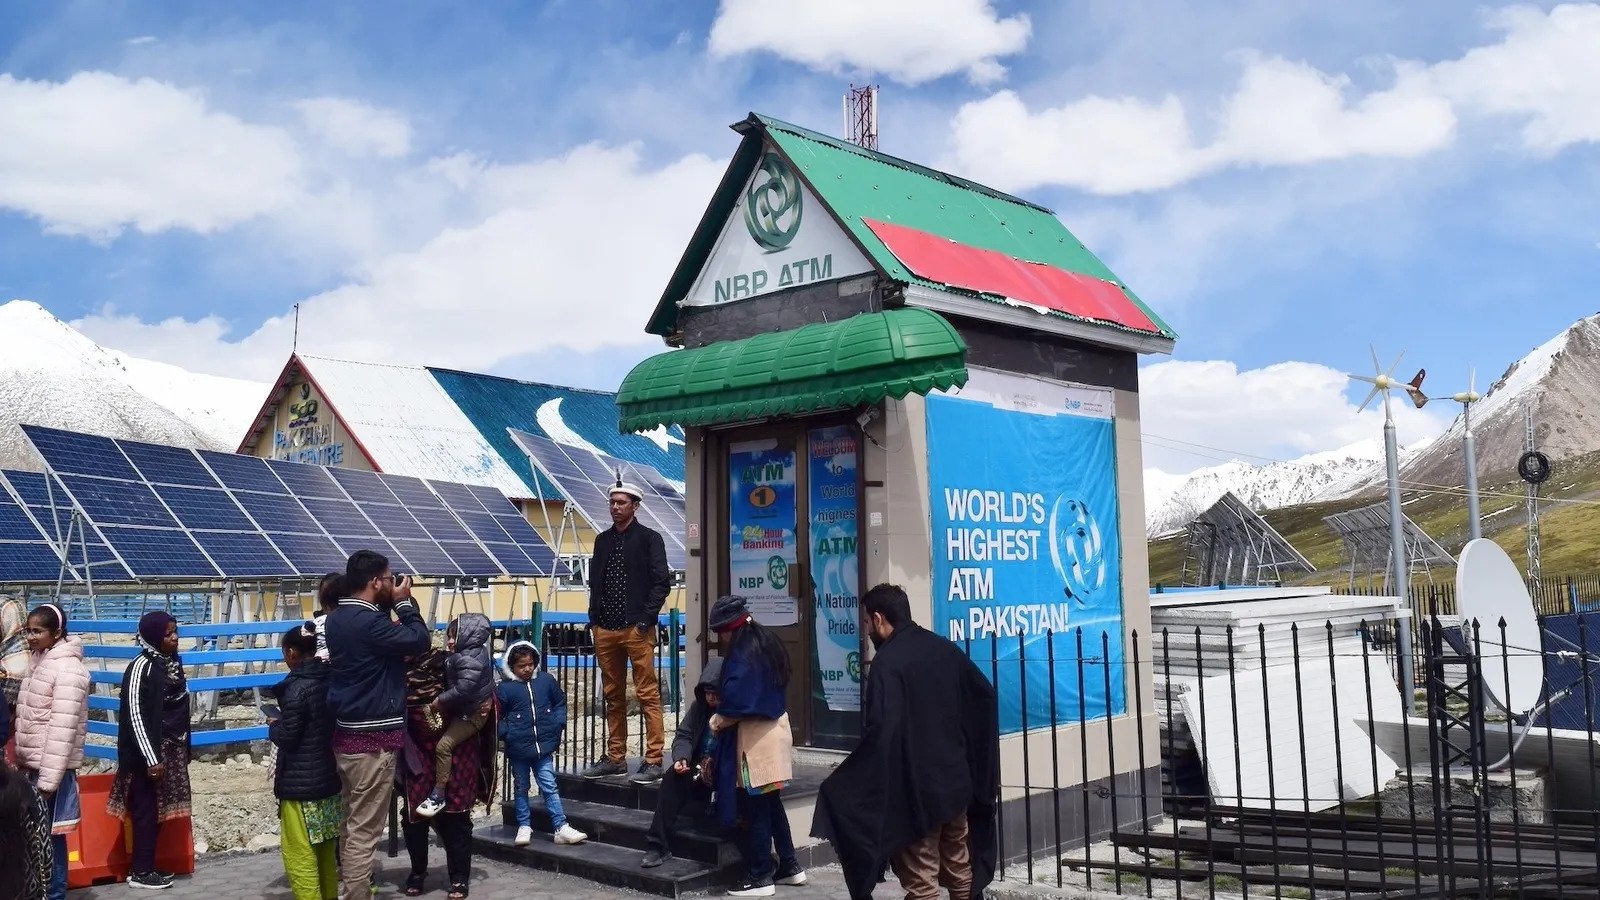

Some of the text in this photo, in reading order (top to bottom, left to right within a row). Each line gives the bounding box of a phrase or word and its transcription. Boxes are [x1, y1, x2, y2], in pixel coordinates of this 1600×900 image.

[714, 254, 833, 302] NBP ATM
[742, 463, 784, 483] ATM
[832, 464, 843, 475] to
[754, 489, 767, 505] 1
[821, 483, 856, 499] World
[945, 488, 1045, 524] WORLD'S
[743, 525, 783, 540] 24 Hour
[743, 539, 784, 550] Banking
[947, 528, 1041, 561] HIGHEST
[739, 577, 764, 588] NBP
[948, 567, 994, 601] ATM
[817, 594, 822, 608] A
[828, 619, 855, 635] Pride
[950, 603, 1069, 641] IN PAKISTAN!
[821, 670, 844, 682] NBP
